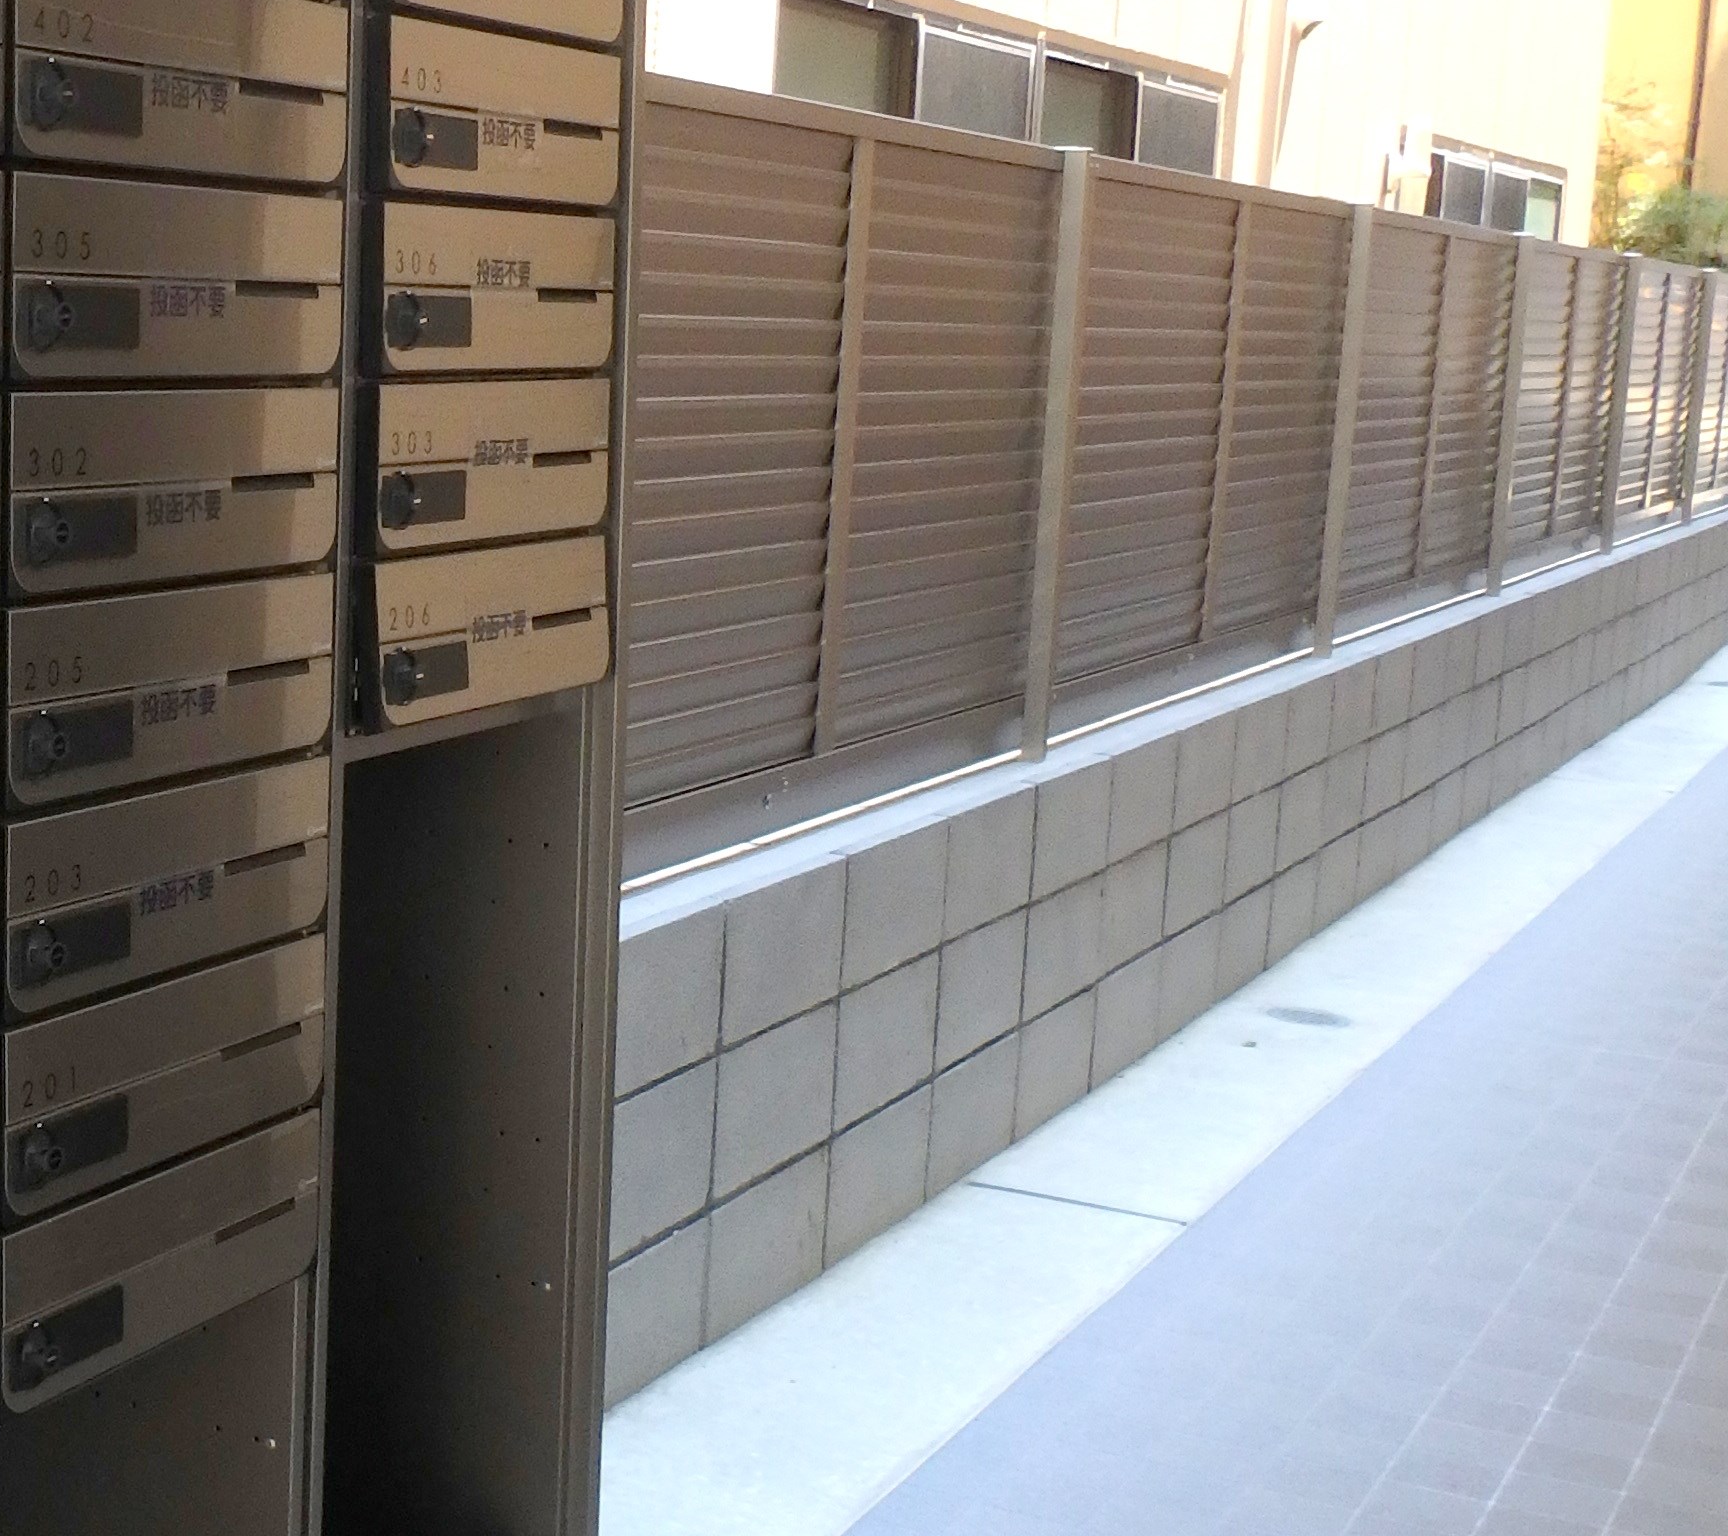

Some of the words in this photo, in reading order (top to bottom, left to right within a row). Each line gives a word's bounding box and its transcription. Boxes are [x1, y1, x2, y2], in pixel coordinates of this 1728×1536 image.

[34, 7, 94, 43] 402
[400, 67, 443, 94] 403
[32, 230, 91, 261] 305
[29, 447, 87, 477] 302
